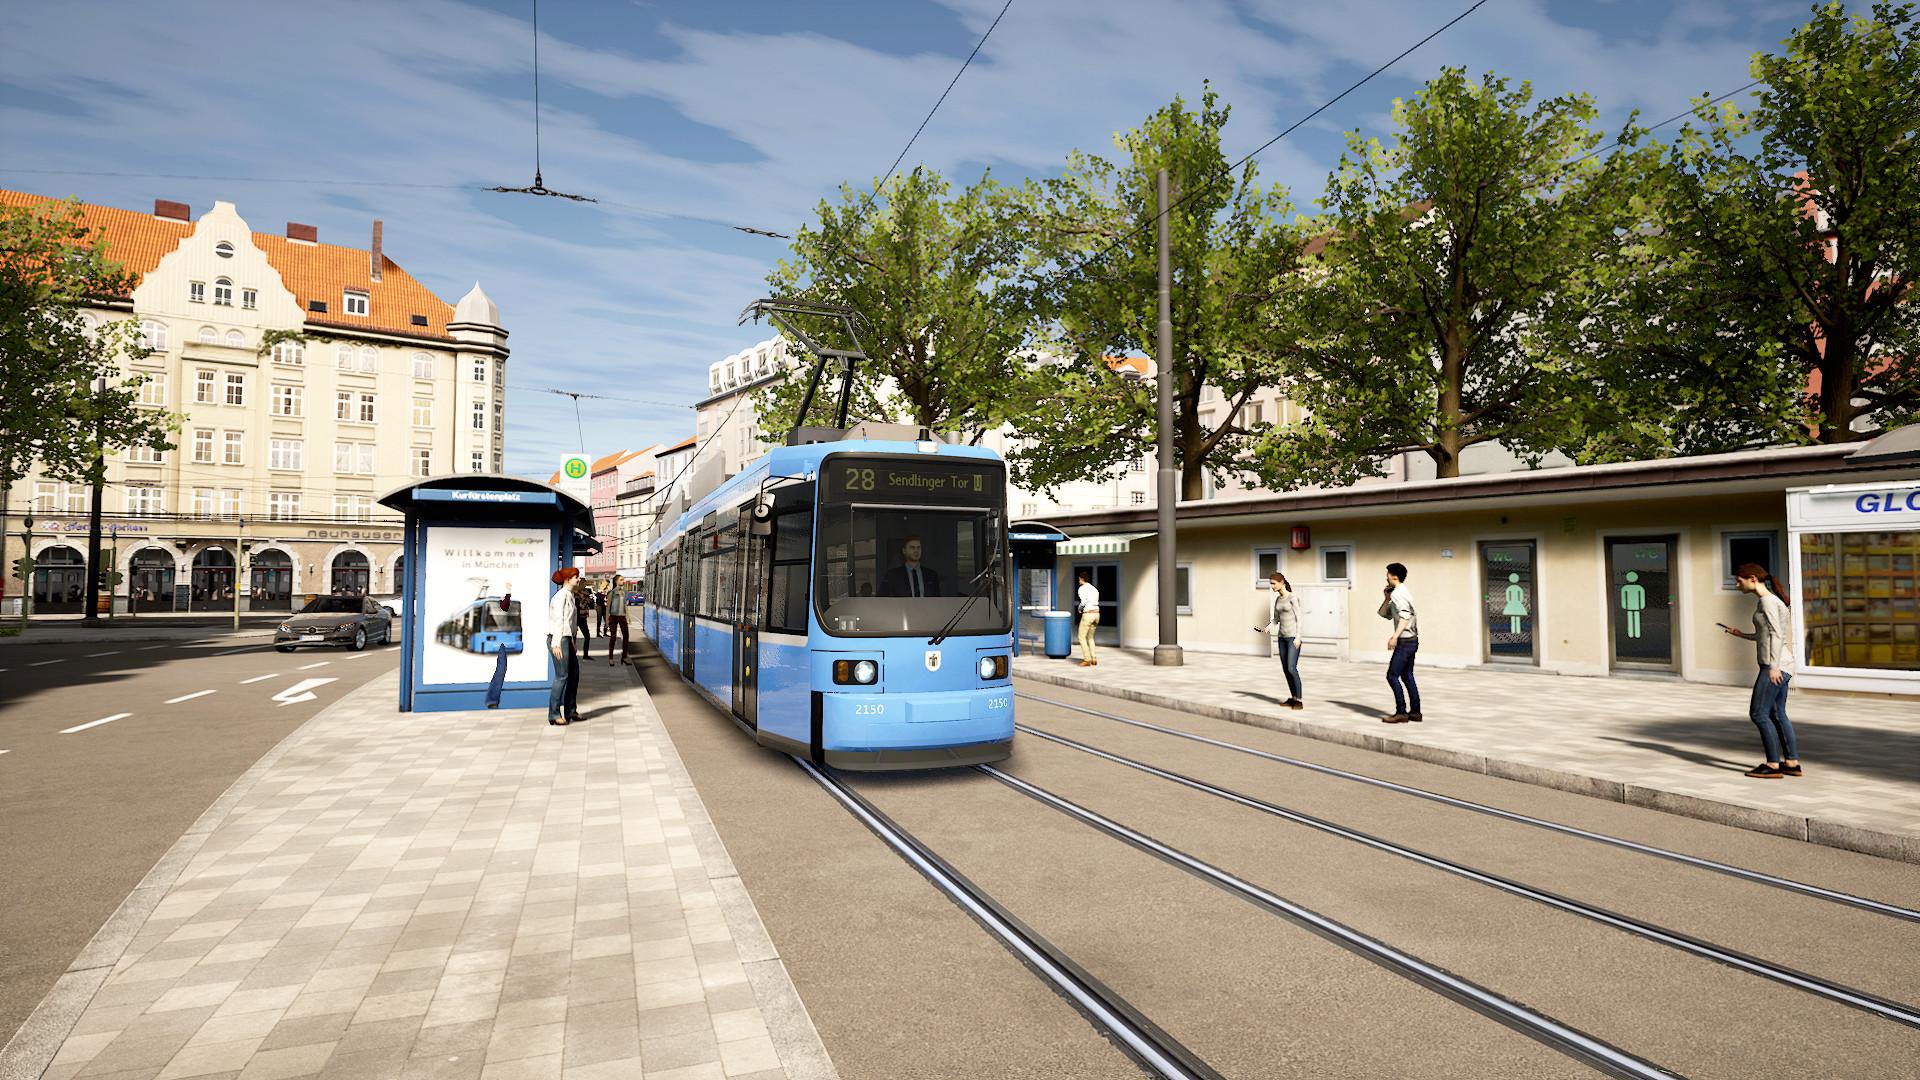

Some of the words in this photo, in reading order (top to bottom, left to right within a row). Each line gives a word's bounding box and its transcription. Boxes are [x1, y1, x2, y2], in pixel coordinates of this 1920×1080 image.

[846, 468, 875, 490] 28
[888, 472, 946, 491] Sendlinger
[950, 475, 969, 489] Tor
[307, 529, 401, 539] neuhauser
[444, 549, 534, 558] Willkommen
[1491, 551, 1513, 562] WC
[462, 561, 471, 569] in
[474, 560, 520, 569] München
[855, 704, 885, 715] 2150
